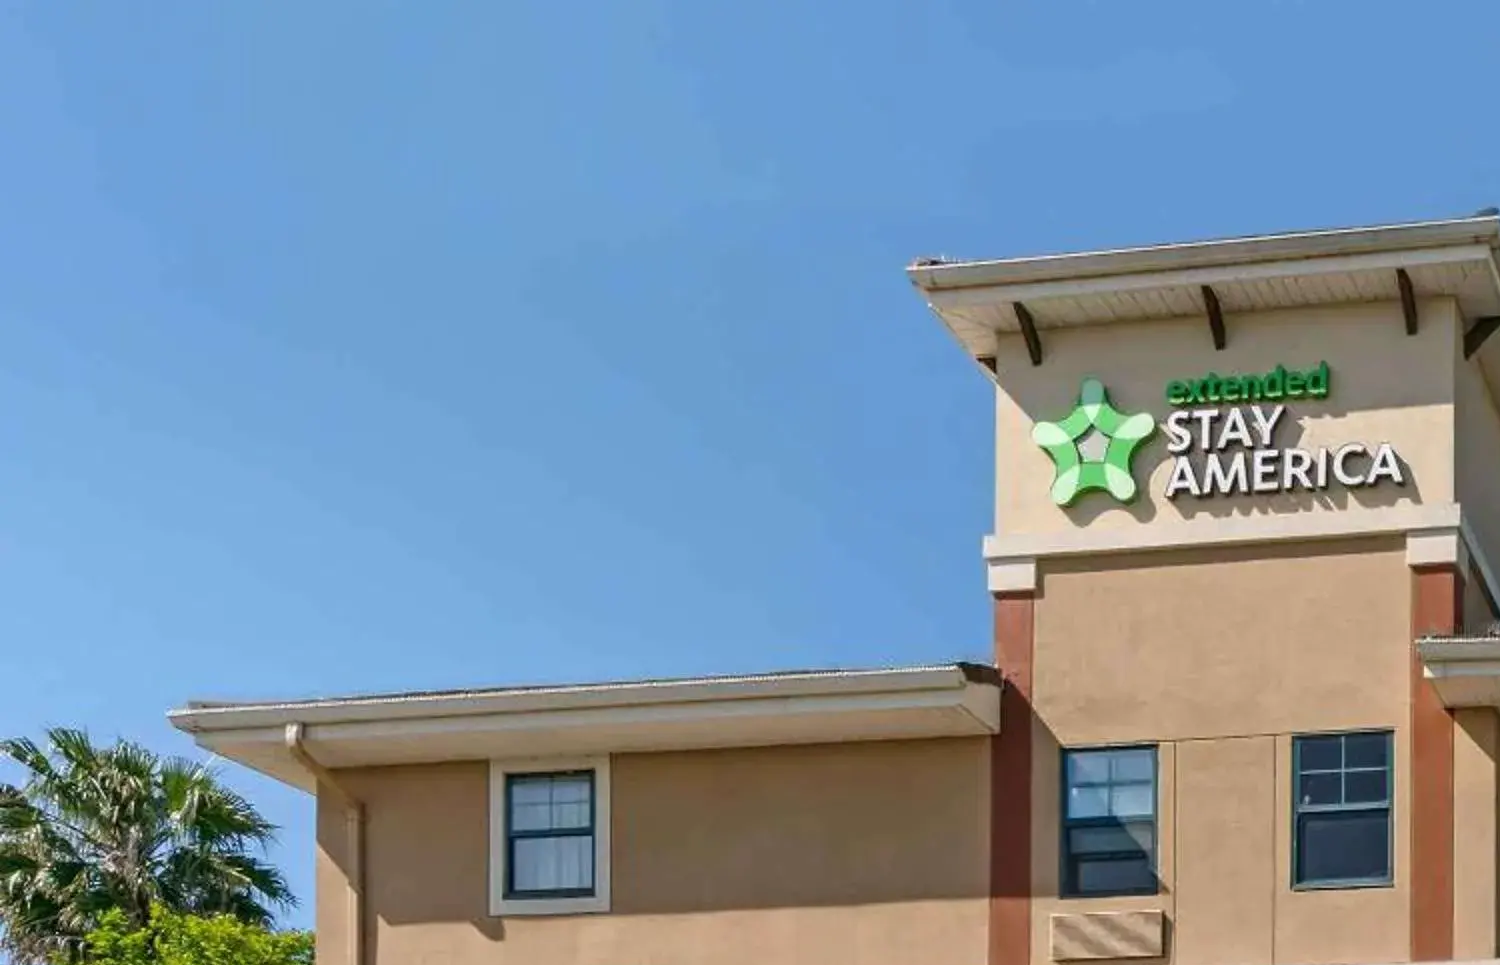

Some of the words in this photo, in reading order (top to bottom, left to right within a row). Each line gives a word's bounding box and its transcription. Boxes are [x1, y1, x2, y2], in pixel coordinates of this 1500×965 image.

[1166, 360, 1330, 404] extended
[1166, 404, 1287, 454] STAY
[1165, 443, 1404, 498] AMERICA
